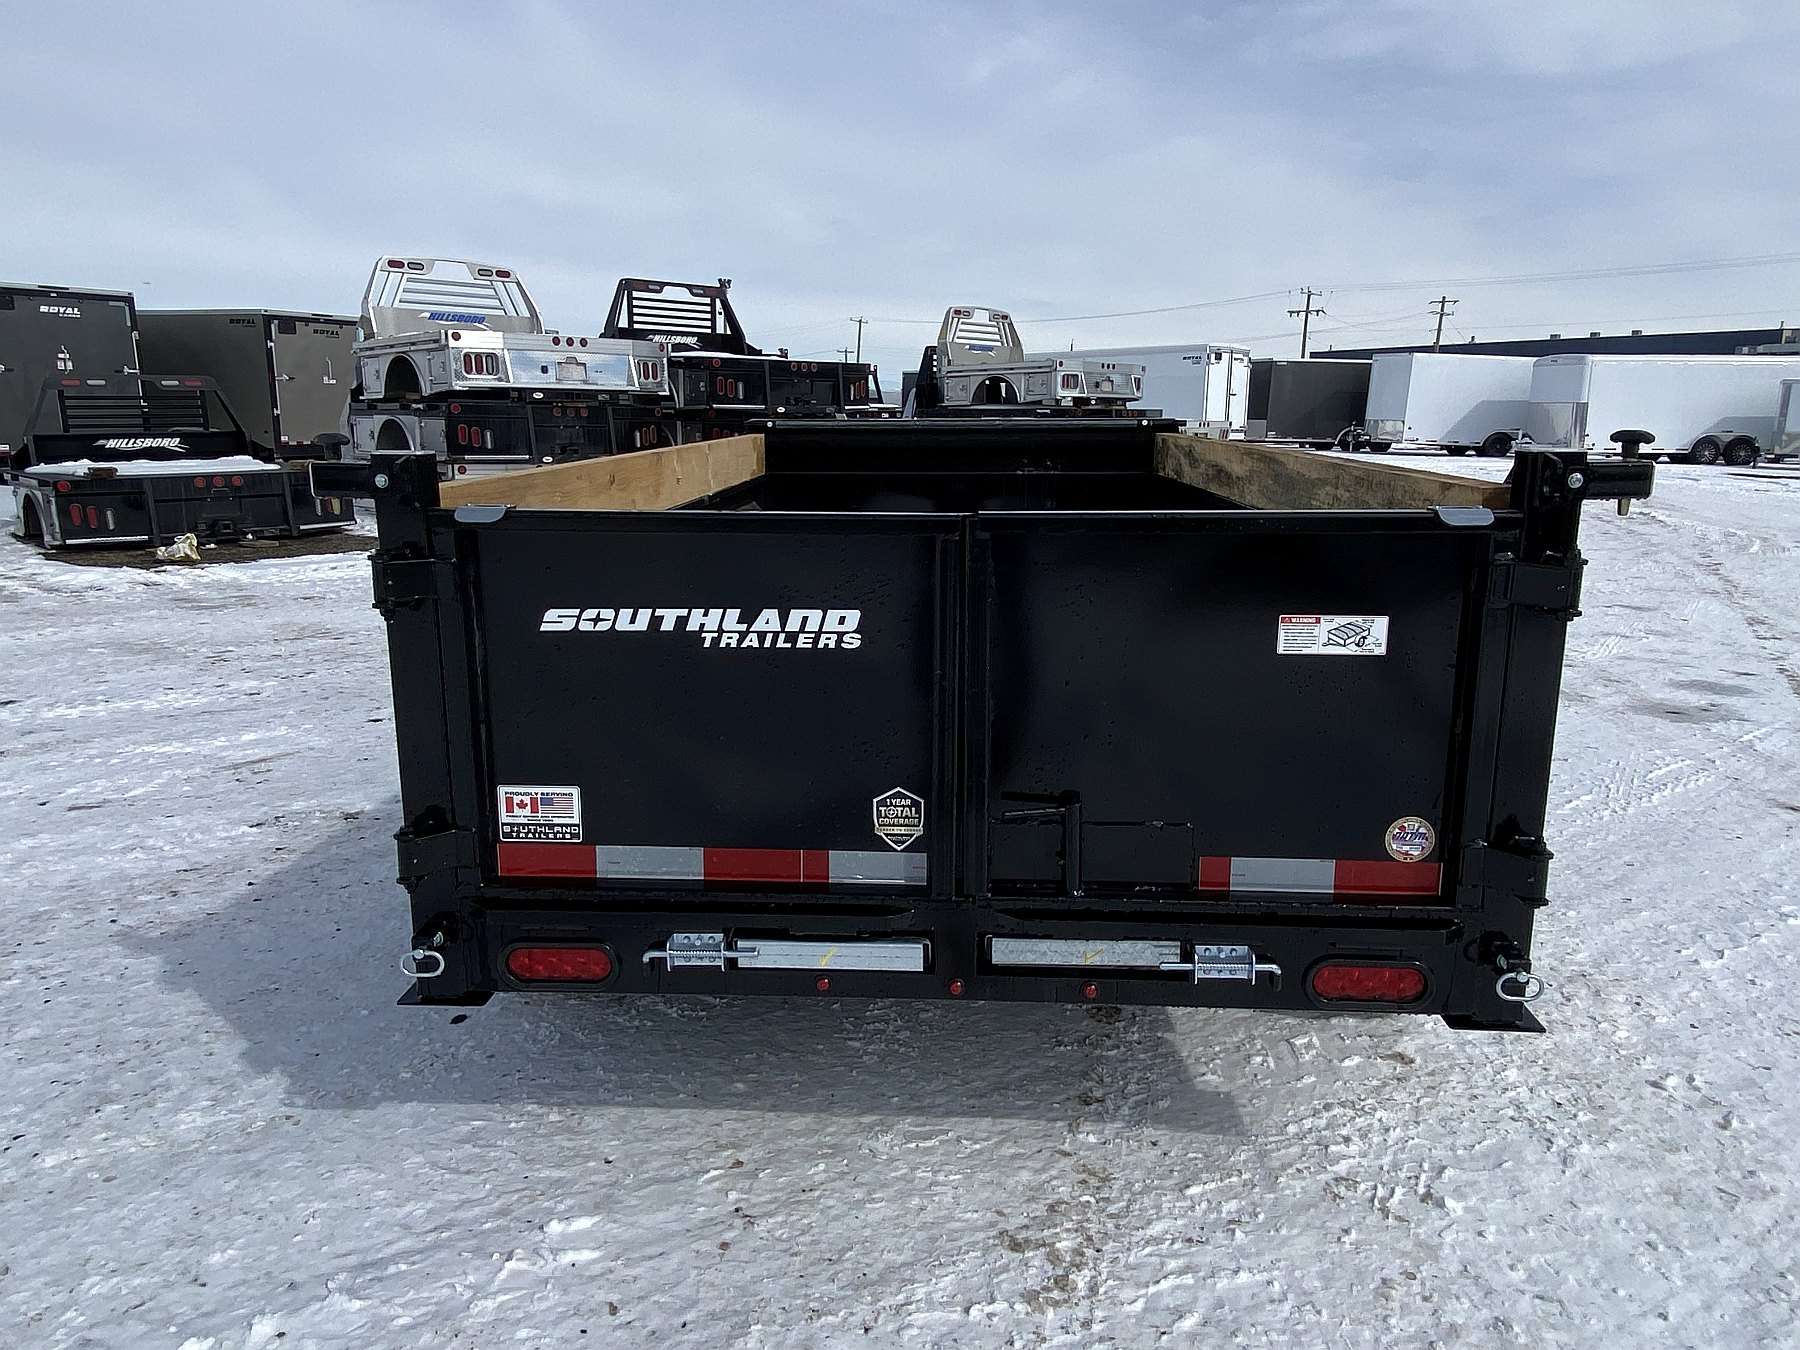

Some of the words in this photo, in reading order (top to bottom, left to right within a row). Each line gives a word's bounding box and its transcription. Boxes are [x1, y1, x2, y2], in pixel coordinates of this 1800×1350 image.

[39, 305, 81, 314] ROYAL
[427, 311, 487, 325] HILLSBORO
[652, 334, 698, 344] HILLSBORO
[104, 437, 181, 449] HILLSBORO
[539, 608, 862, 632] SOUTHLAND
[700, 632, 863, 650] TRAILERS
[886, 798, 891, 806] 1
[891, 798, 912, 806] YEAR
[878, 806, 920, 818] TOTAL
[878, 818, 920, 826] COVERAGE
